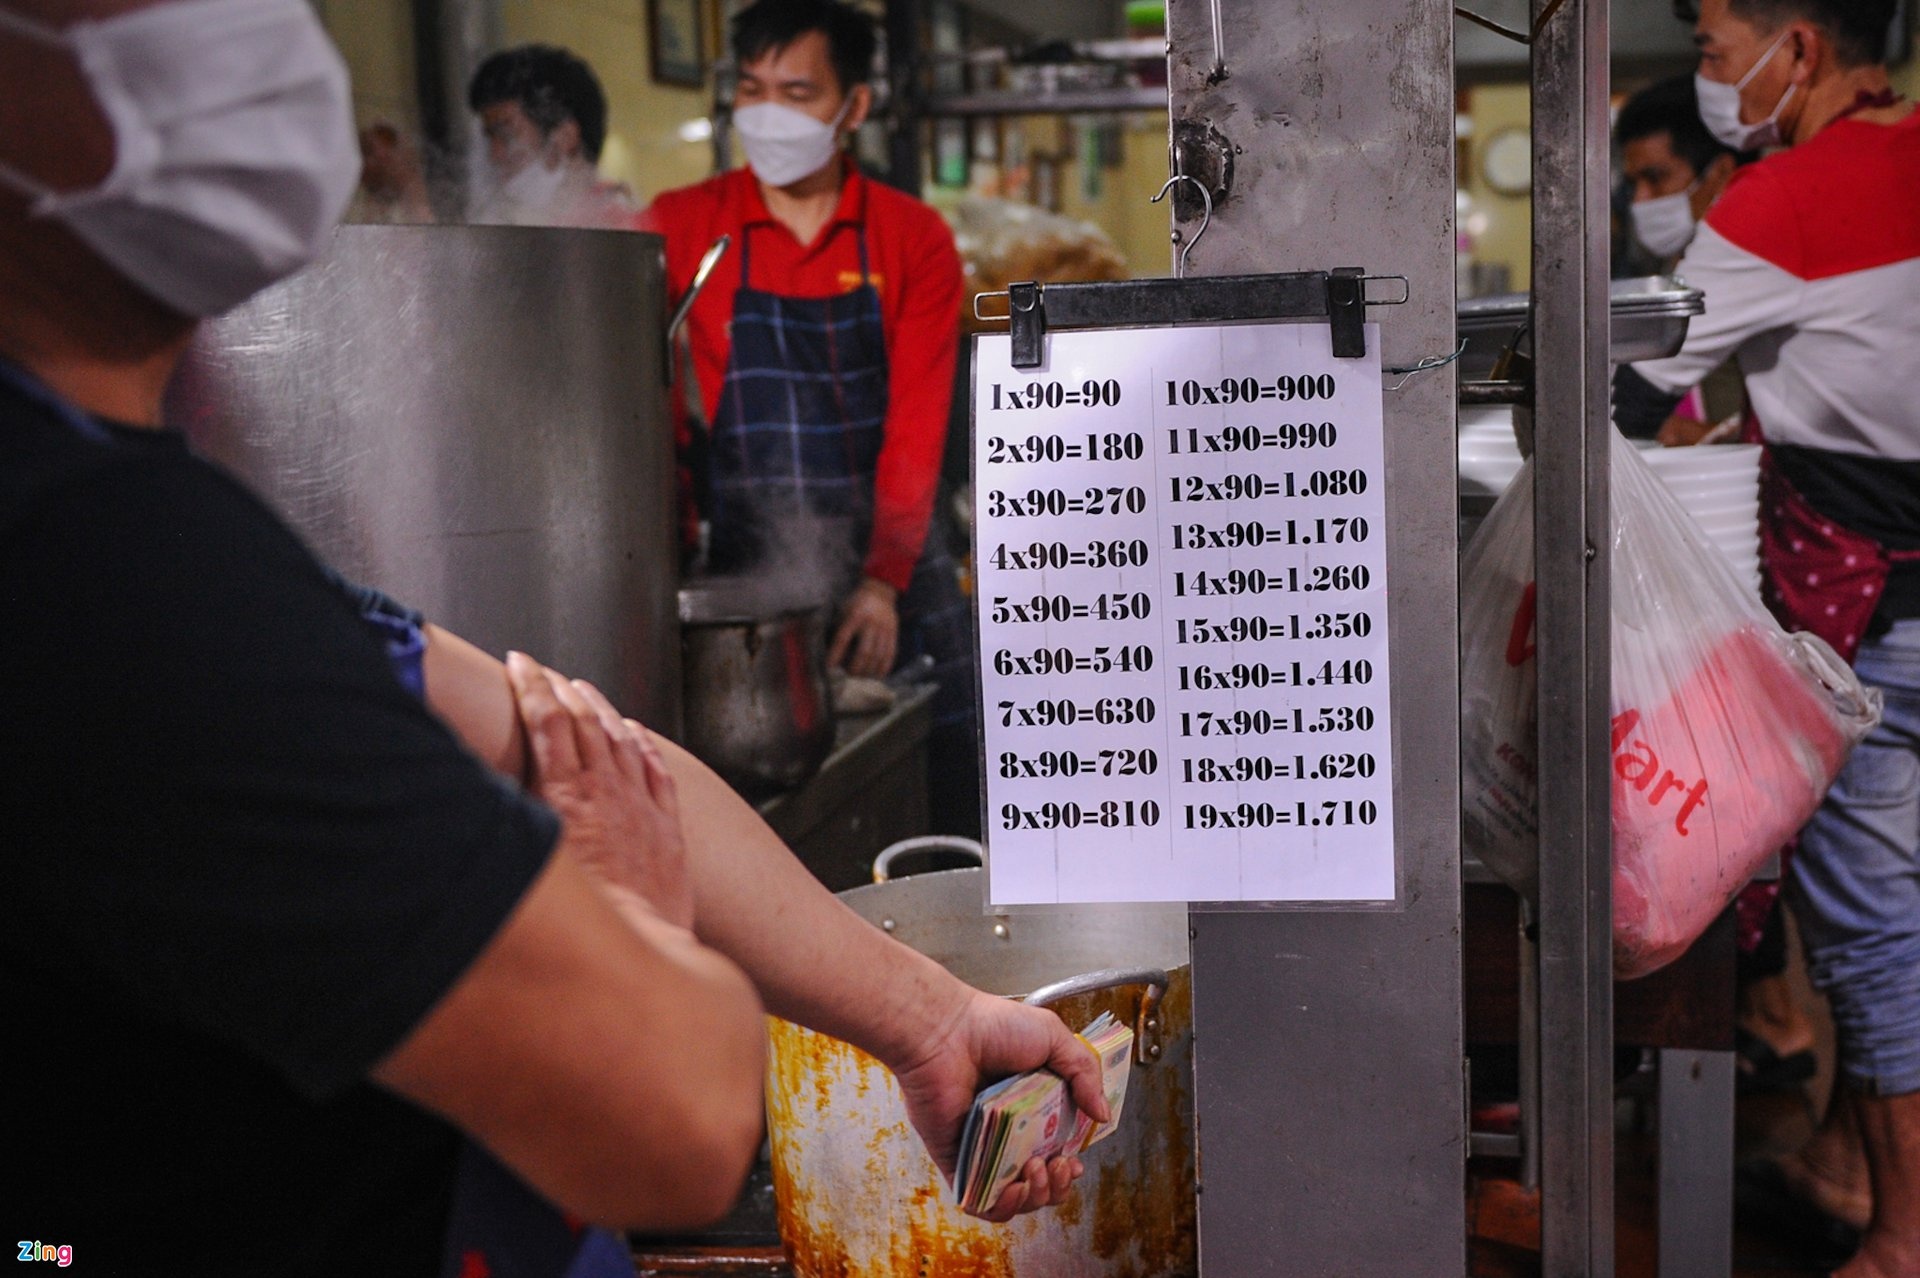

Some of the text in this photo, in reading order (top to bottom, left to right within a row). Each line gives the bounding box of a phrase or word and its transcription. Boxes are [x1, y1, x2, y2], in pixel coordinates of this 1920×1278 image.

[992, 379, 1121, 410] 1x90=90
[1166, 372, 1337, 407] 10x90=900
[987, 432, 1144, 464] 2x90=180
[1168, 420, 1339, 455] 11x90=990
[1169, 468, 1368, 502] 12x90=1.080
[987, 486, 1146, 518] 3x90=270
[1171, 516, 1369, 550] 13x90=1.170
[989, 539, 1149, 570] 4x90=360
[1174, 564, 1370, 597] 14x90=1.260
[991, 592, 1151, 624] 5x90=450
[1176, 612, 1372, 644] 15x90=1.350
[992, 645, 1154, 676] 6x90=540
[1177, 659, 1373, 691] 16x90=1.440
[996, 696, 1156, 728] 7x90=630
[1180, 706, 1374, 737] 17x90=1.530
[998, 748, 1158, 779] 8x90=720
[1182, 753, 1376, 783] 18x90=1.620
[1000, 799, 1160, 830] 9x90=810
[1184, 800, 1377, 829] 19x90=1.710
